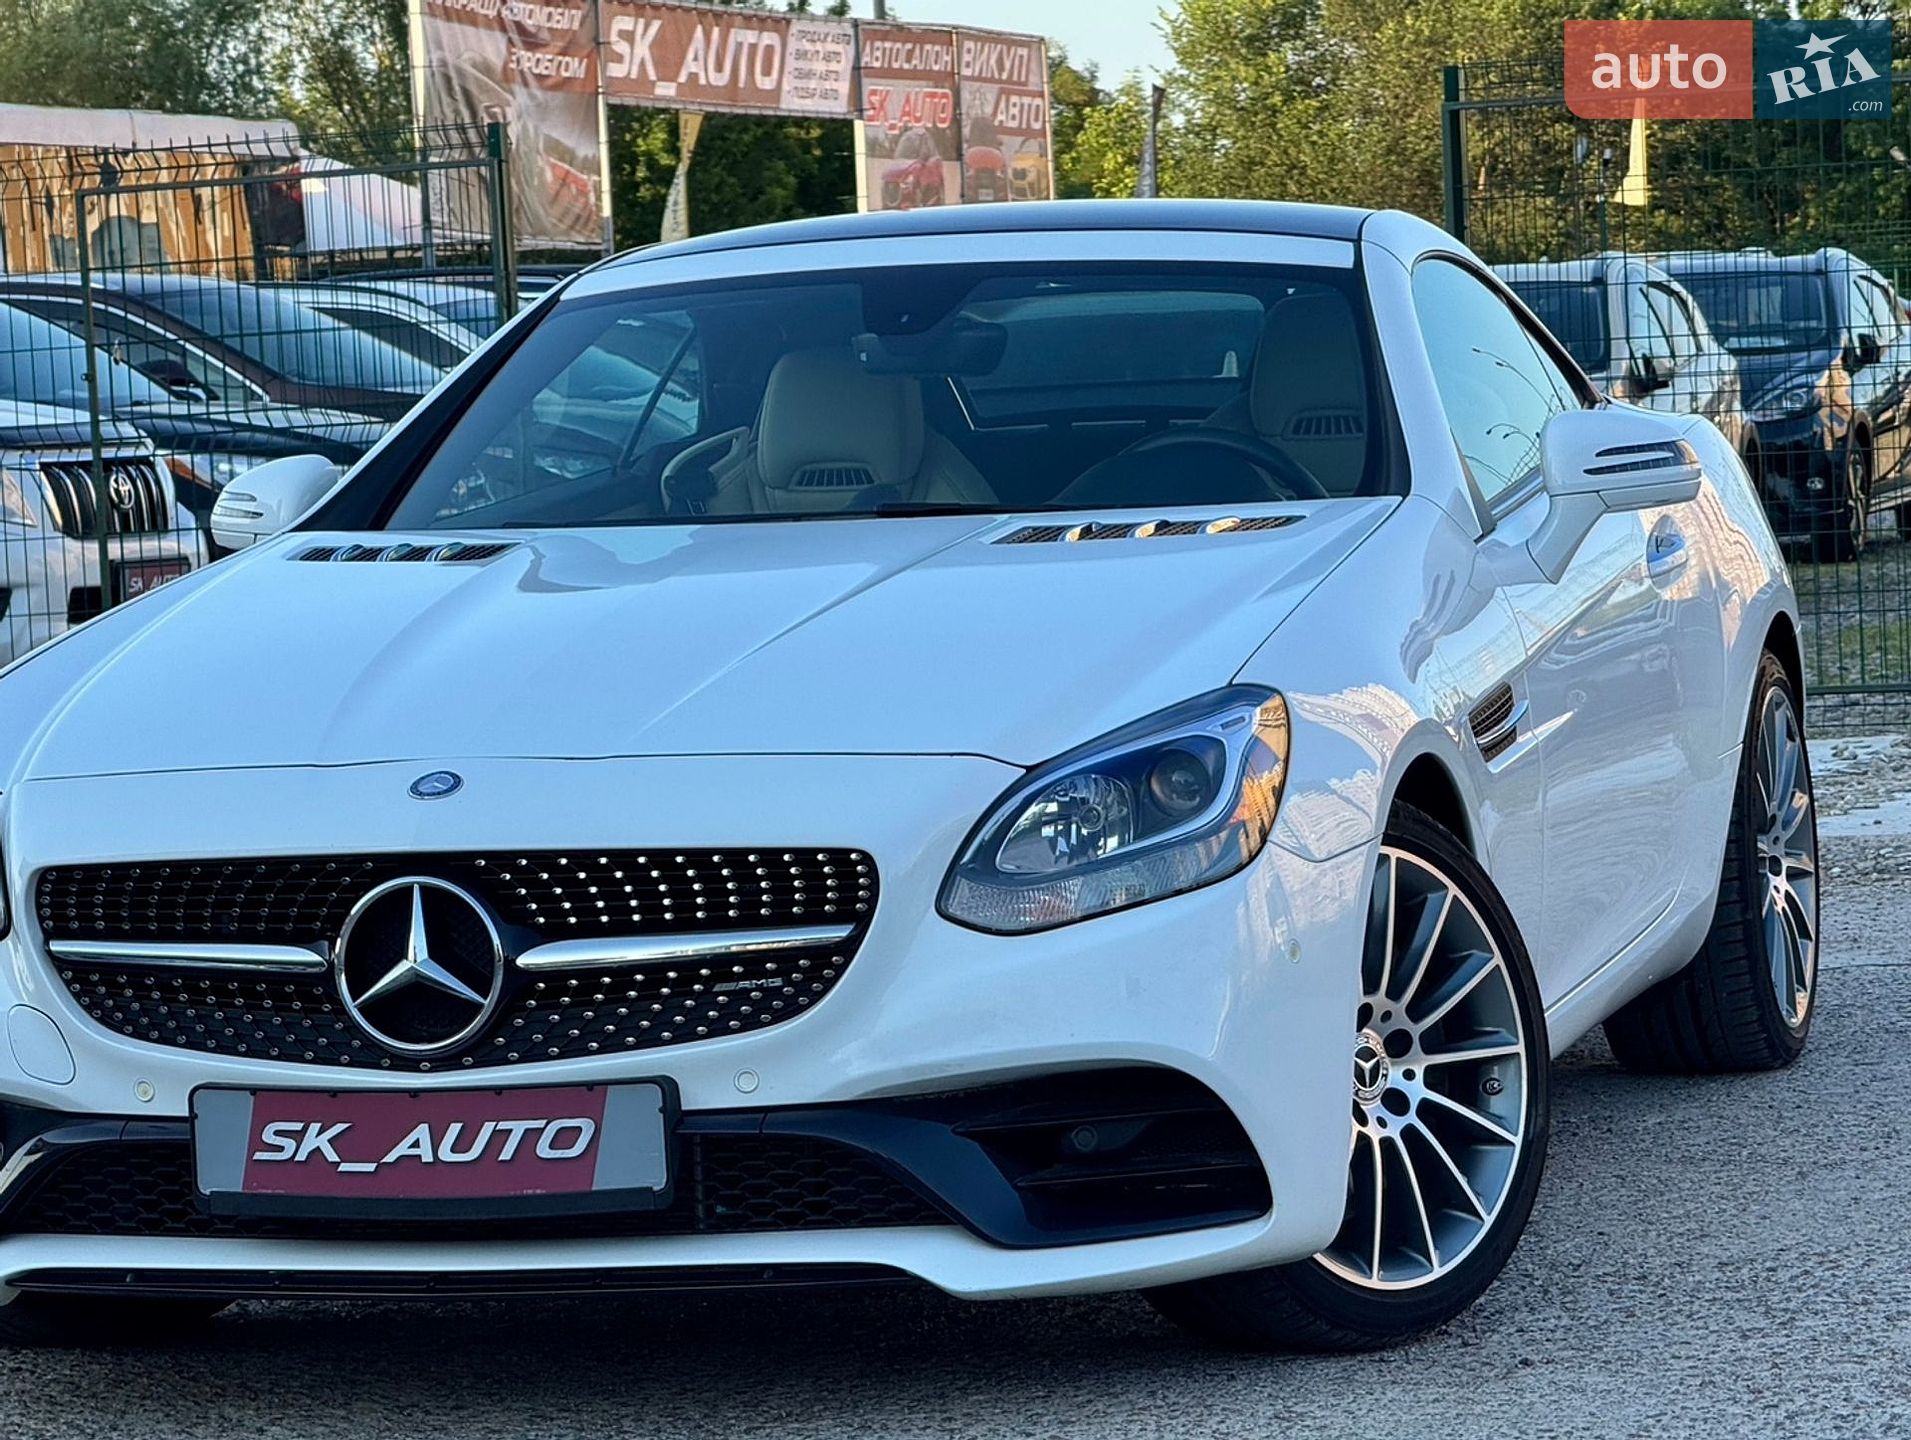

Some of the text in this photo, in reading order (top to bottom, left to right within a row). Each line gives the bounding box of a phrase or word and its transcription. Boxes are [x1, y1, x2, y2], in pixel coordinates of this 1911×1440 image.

[606, 15, 782, 96] SK_AUTO
[862, 40, 951, 71] АВТОСАЛОН
[961, 41, 1029, 81] ВИКУП
[864, 85, 953, 134] SK_AUTO
[993, 93, 1043, 130] АВТО
[735, 977, 784, 990] AMG
[252, 1117, 595, 1172] SK_AUTO
